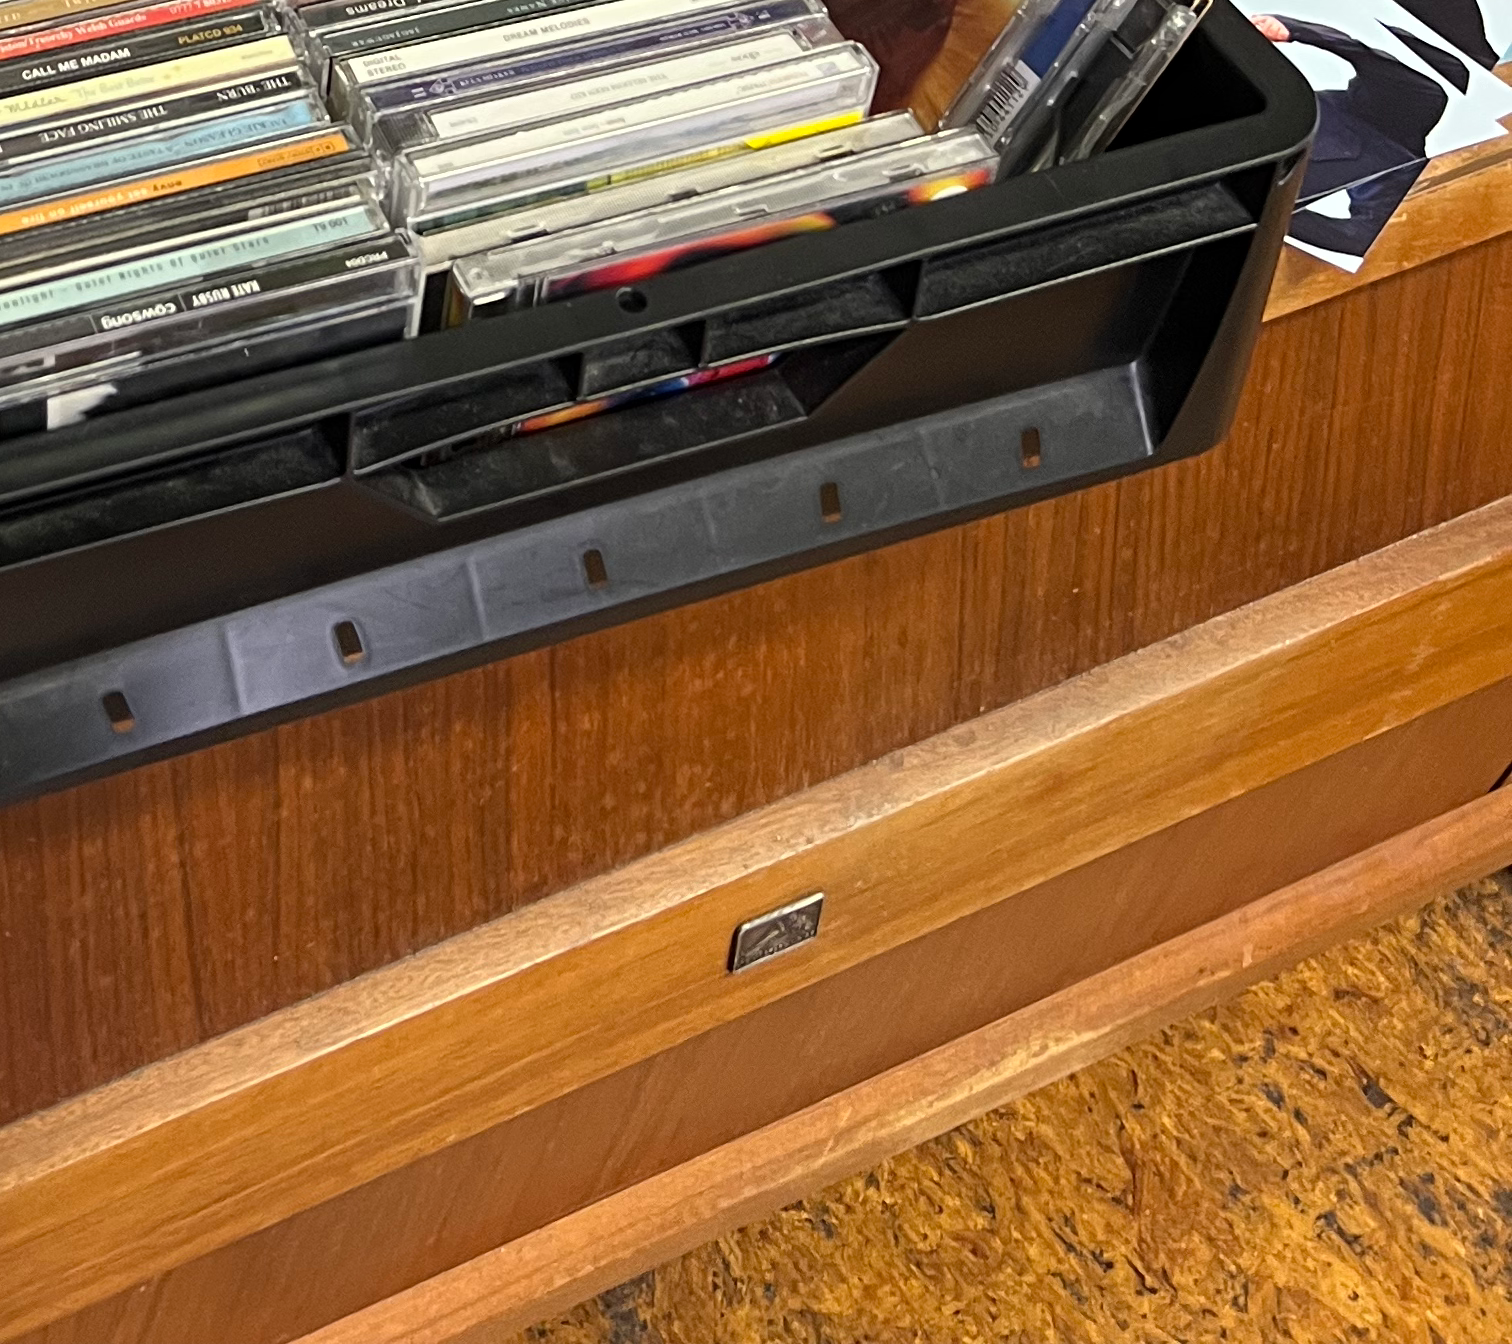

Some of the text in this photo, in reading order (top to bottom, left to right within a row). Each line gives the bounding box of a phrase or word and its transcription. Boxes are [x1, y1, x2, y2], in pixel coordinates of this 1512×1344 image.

[21, 64, 56, 81] CALL
[58, 59, 79, 72] ME
[80, 47, 131, 67] MADAM
[177, 28, 222, 46] PLATCD
[223, 23, 243, 36] 934
[38, 104, 168, 143] THE SMILING FACE
[192, 288, 232, 307] RUSBY
[237, 279, 261, 297] KATE
[101, 302, 178, 331] cowsong
